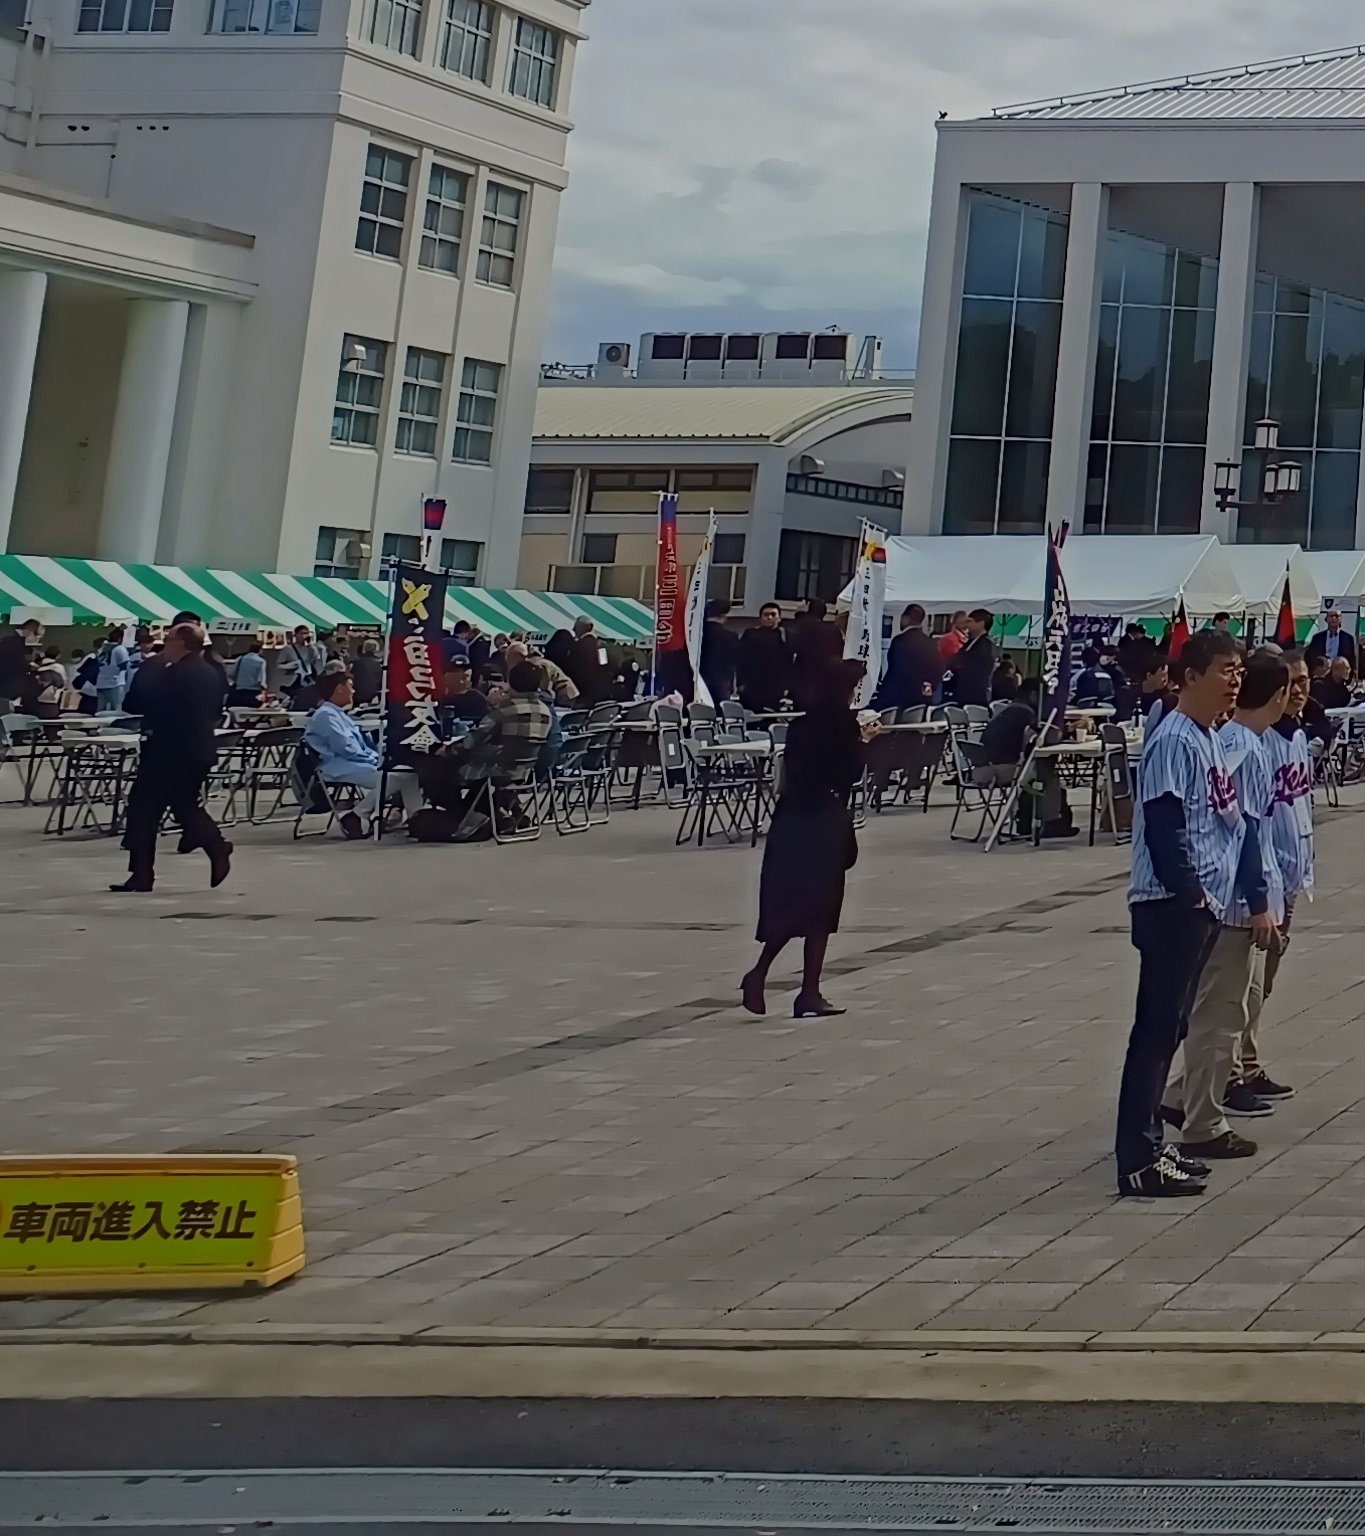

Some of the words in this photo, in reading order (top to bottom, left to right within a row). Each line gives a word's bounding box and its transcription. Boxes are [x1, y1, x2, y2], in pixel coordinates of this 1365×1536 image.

[3, 1199, 257, 1244] 車両進入禁止
